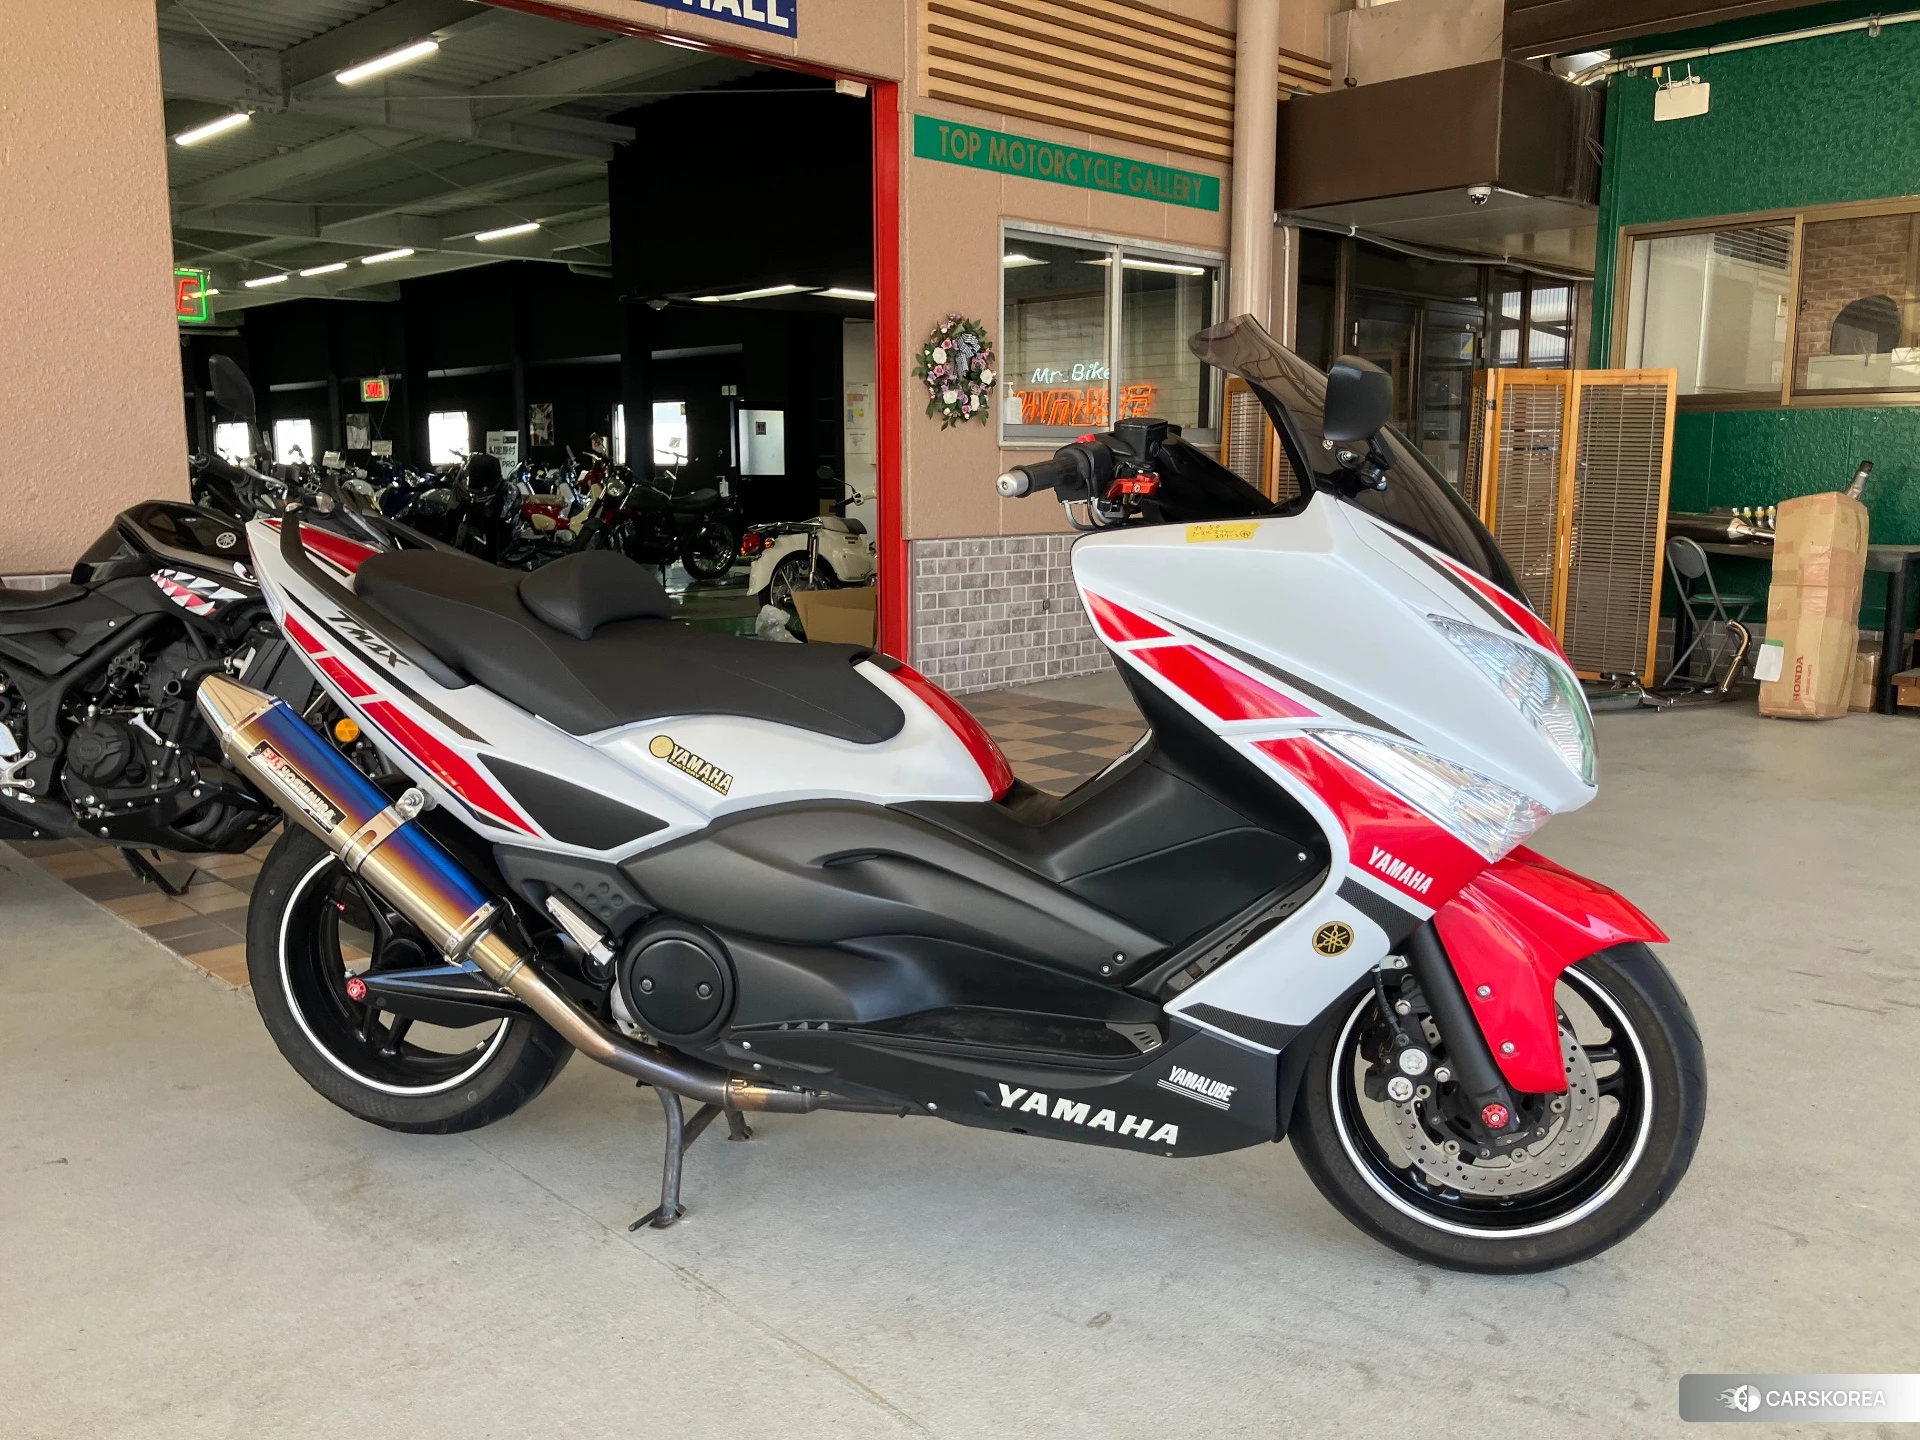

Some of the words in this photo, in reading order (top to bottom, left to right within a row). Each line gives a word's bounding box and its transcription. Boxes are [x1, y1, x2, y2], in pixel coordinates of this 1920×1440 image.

[682, 0, 789, 29] ALL
[939, 125, 981, 162] TOP
[988, 136, 1122, 190] MOTORCYCLE
[1127, 165, 1203, 204] GALLERY
[1071, 361, 1110, 382] Bike
[1793, 655, 1804, 701] HONDA
[668, 758, 700, 778] FACTORY
[701, 777, 728, 795] RACING
[670, 745, 732, 791] YAMAHA
[277, 765, 336, 820] YOSHIMURA
[1368, 845, 1434, 894] YAMAHA
[1168, 1065, 1234, 1102] YAMALUBE
[998, 1082, 1179, 1145] YAMAHA
